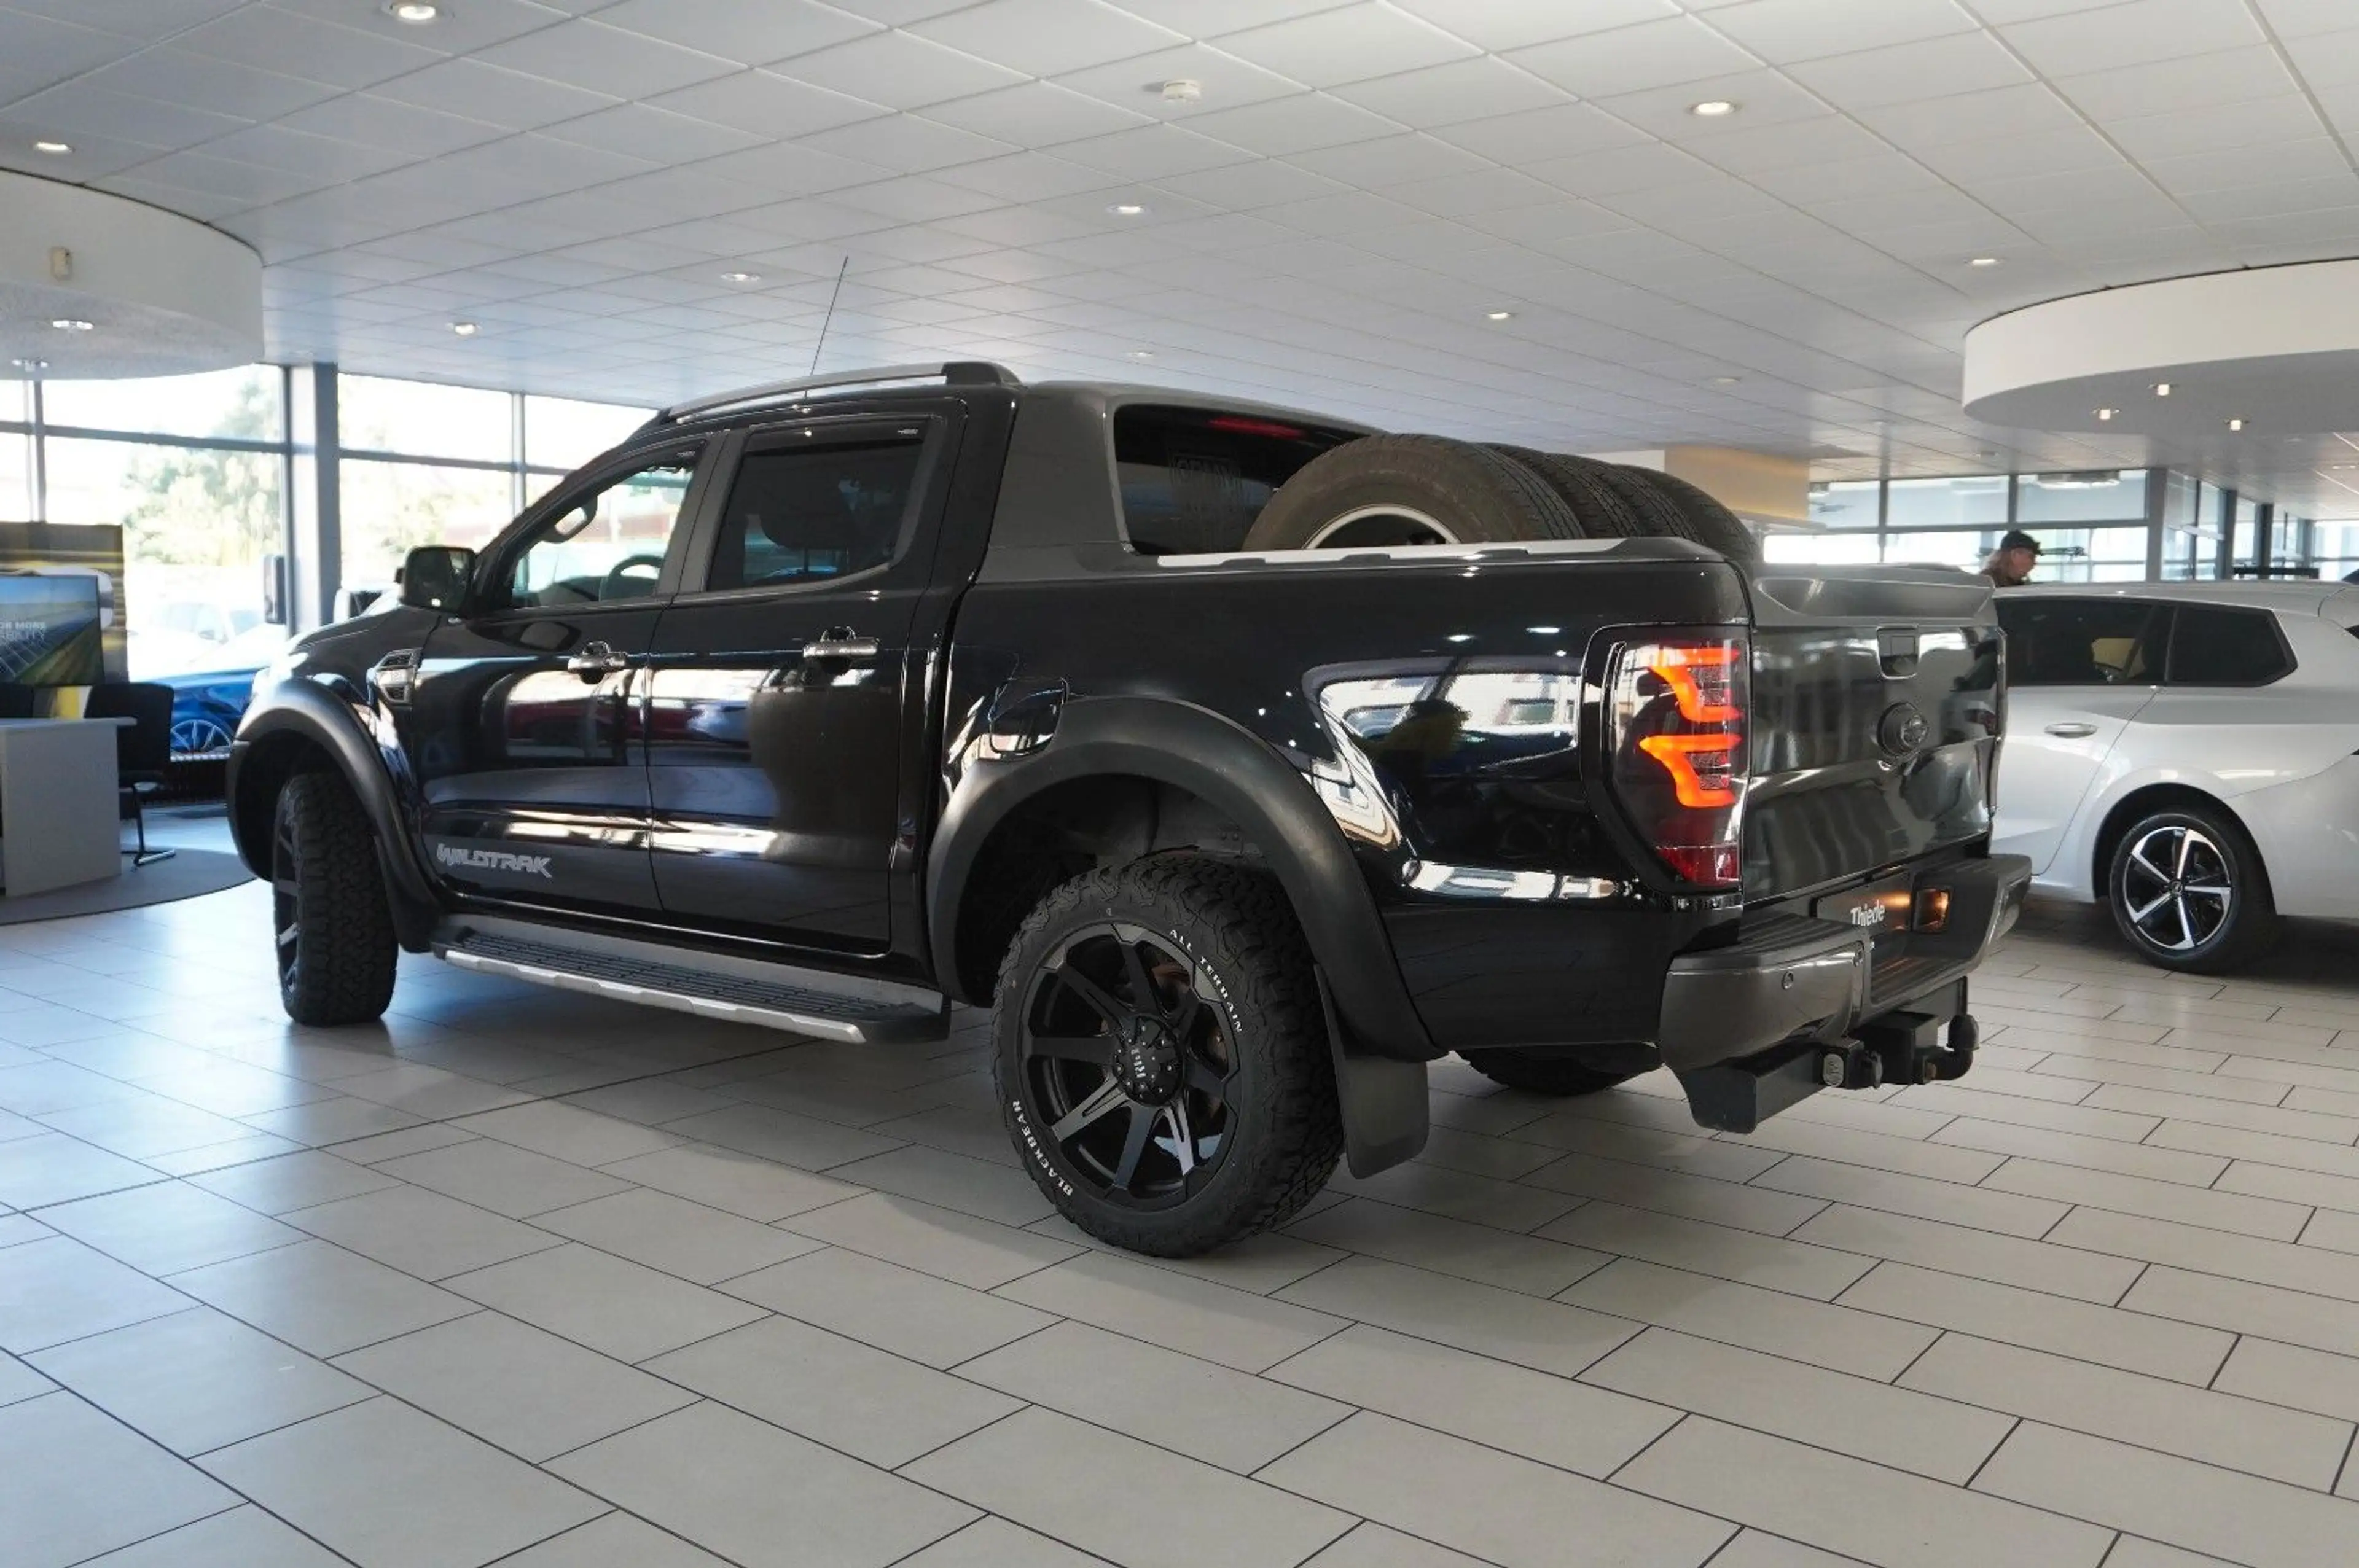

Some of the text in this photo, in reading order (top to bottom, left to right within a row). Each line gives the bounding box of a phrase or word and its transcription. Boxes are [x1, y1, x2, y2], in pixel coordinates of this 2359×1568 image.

[436, 842, 552, 878] WILDTRAK
[1850, 899, 1885, 927] Thiede
[1168, 929, 1243, 1033] ALL TERRAIN
[1012, 1099, 1074, 1196] BLACKBEAR
